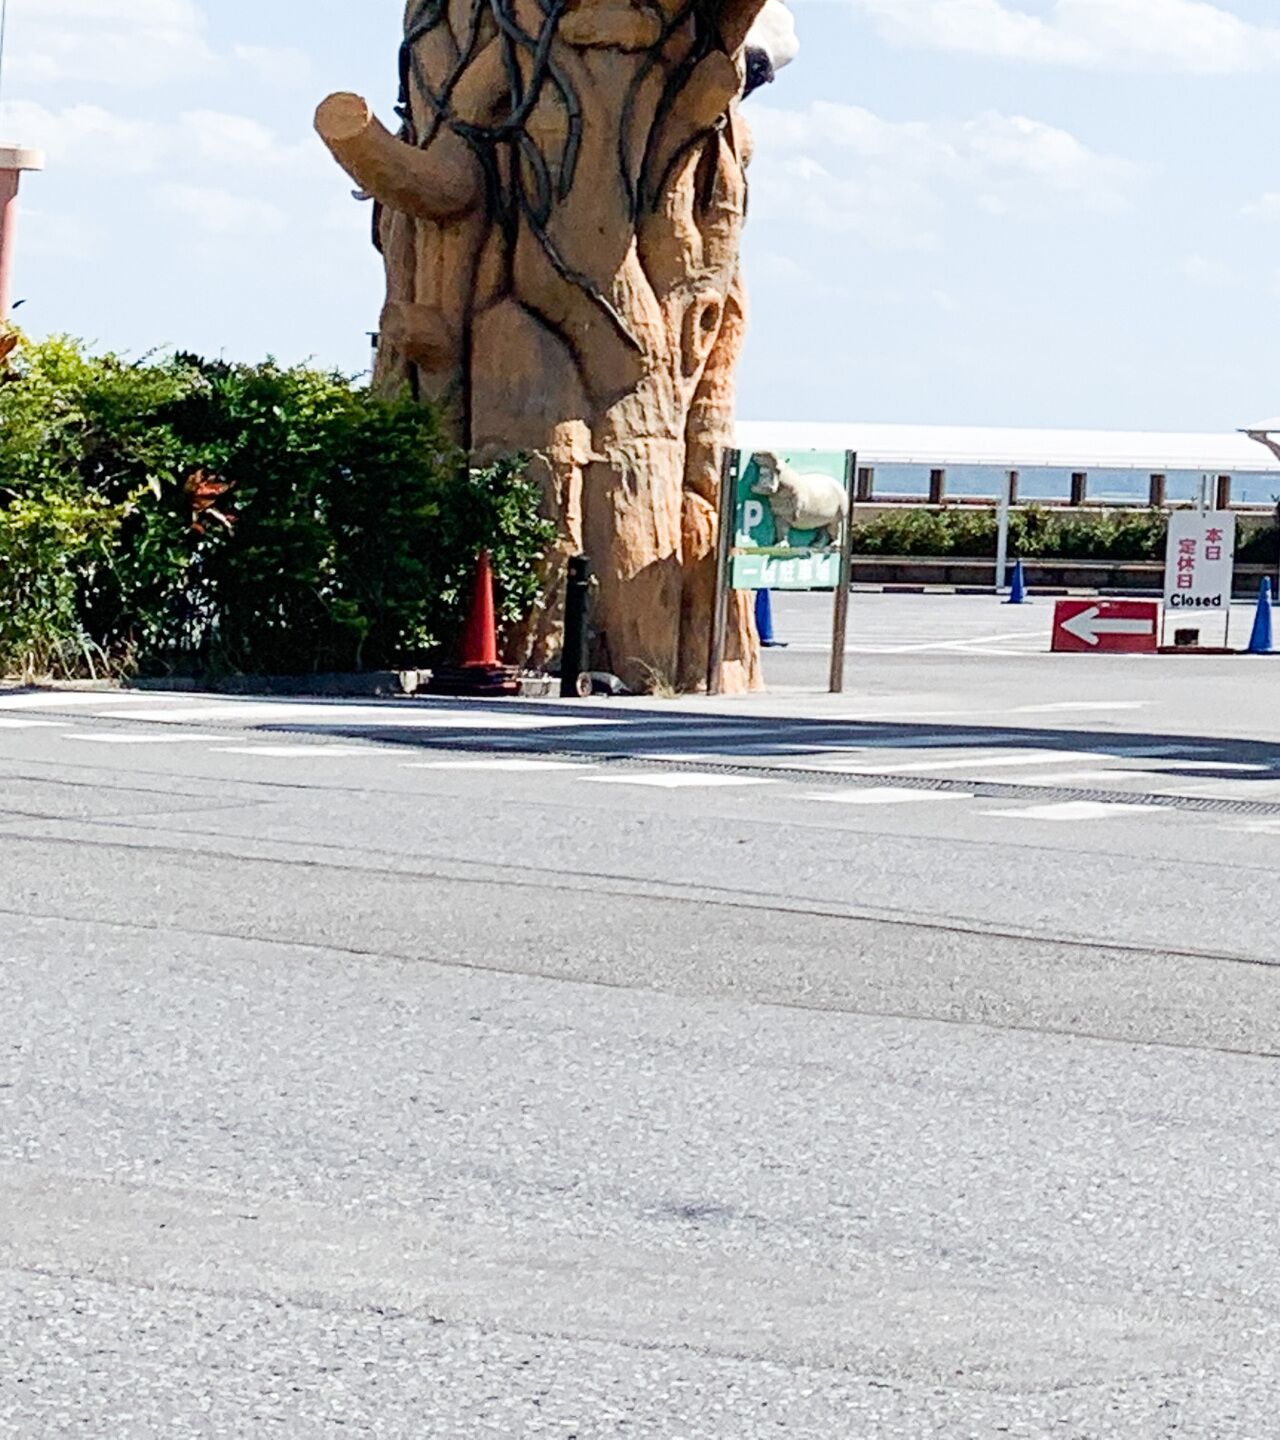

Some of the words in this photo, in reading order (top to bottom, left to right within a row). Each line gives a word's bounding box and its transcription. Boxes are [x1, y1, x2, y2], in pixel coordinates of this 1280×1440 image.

[1206, 528, 1223, 560] 本日
[1177, 539, 1197, 588] 定休日
[1171, 593, 1221, 607] Closed
